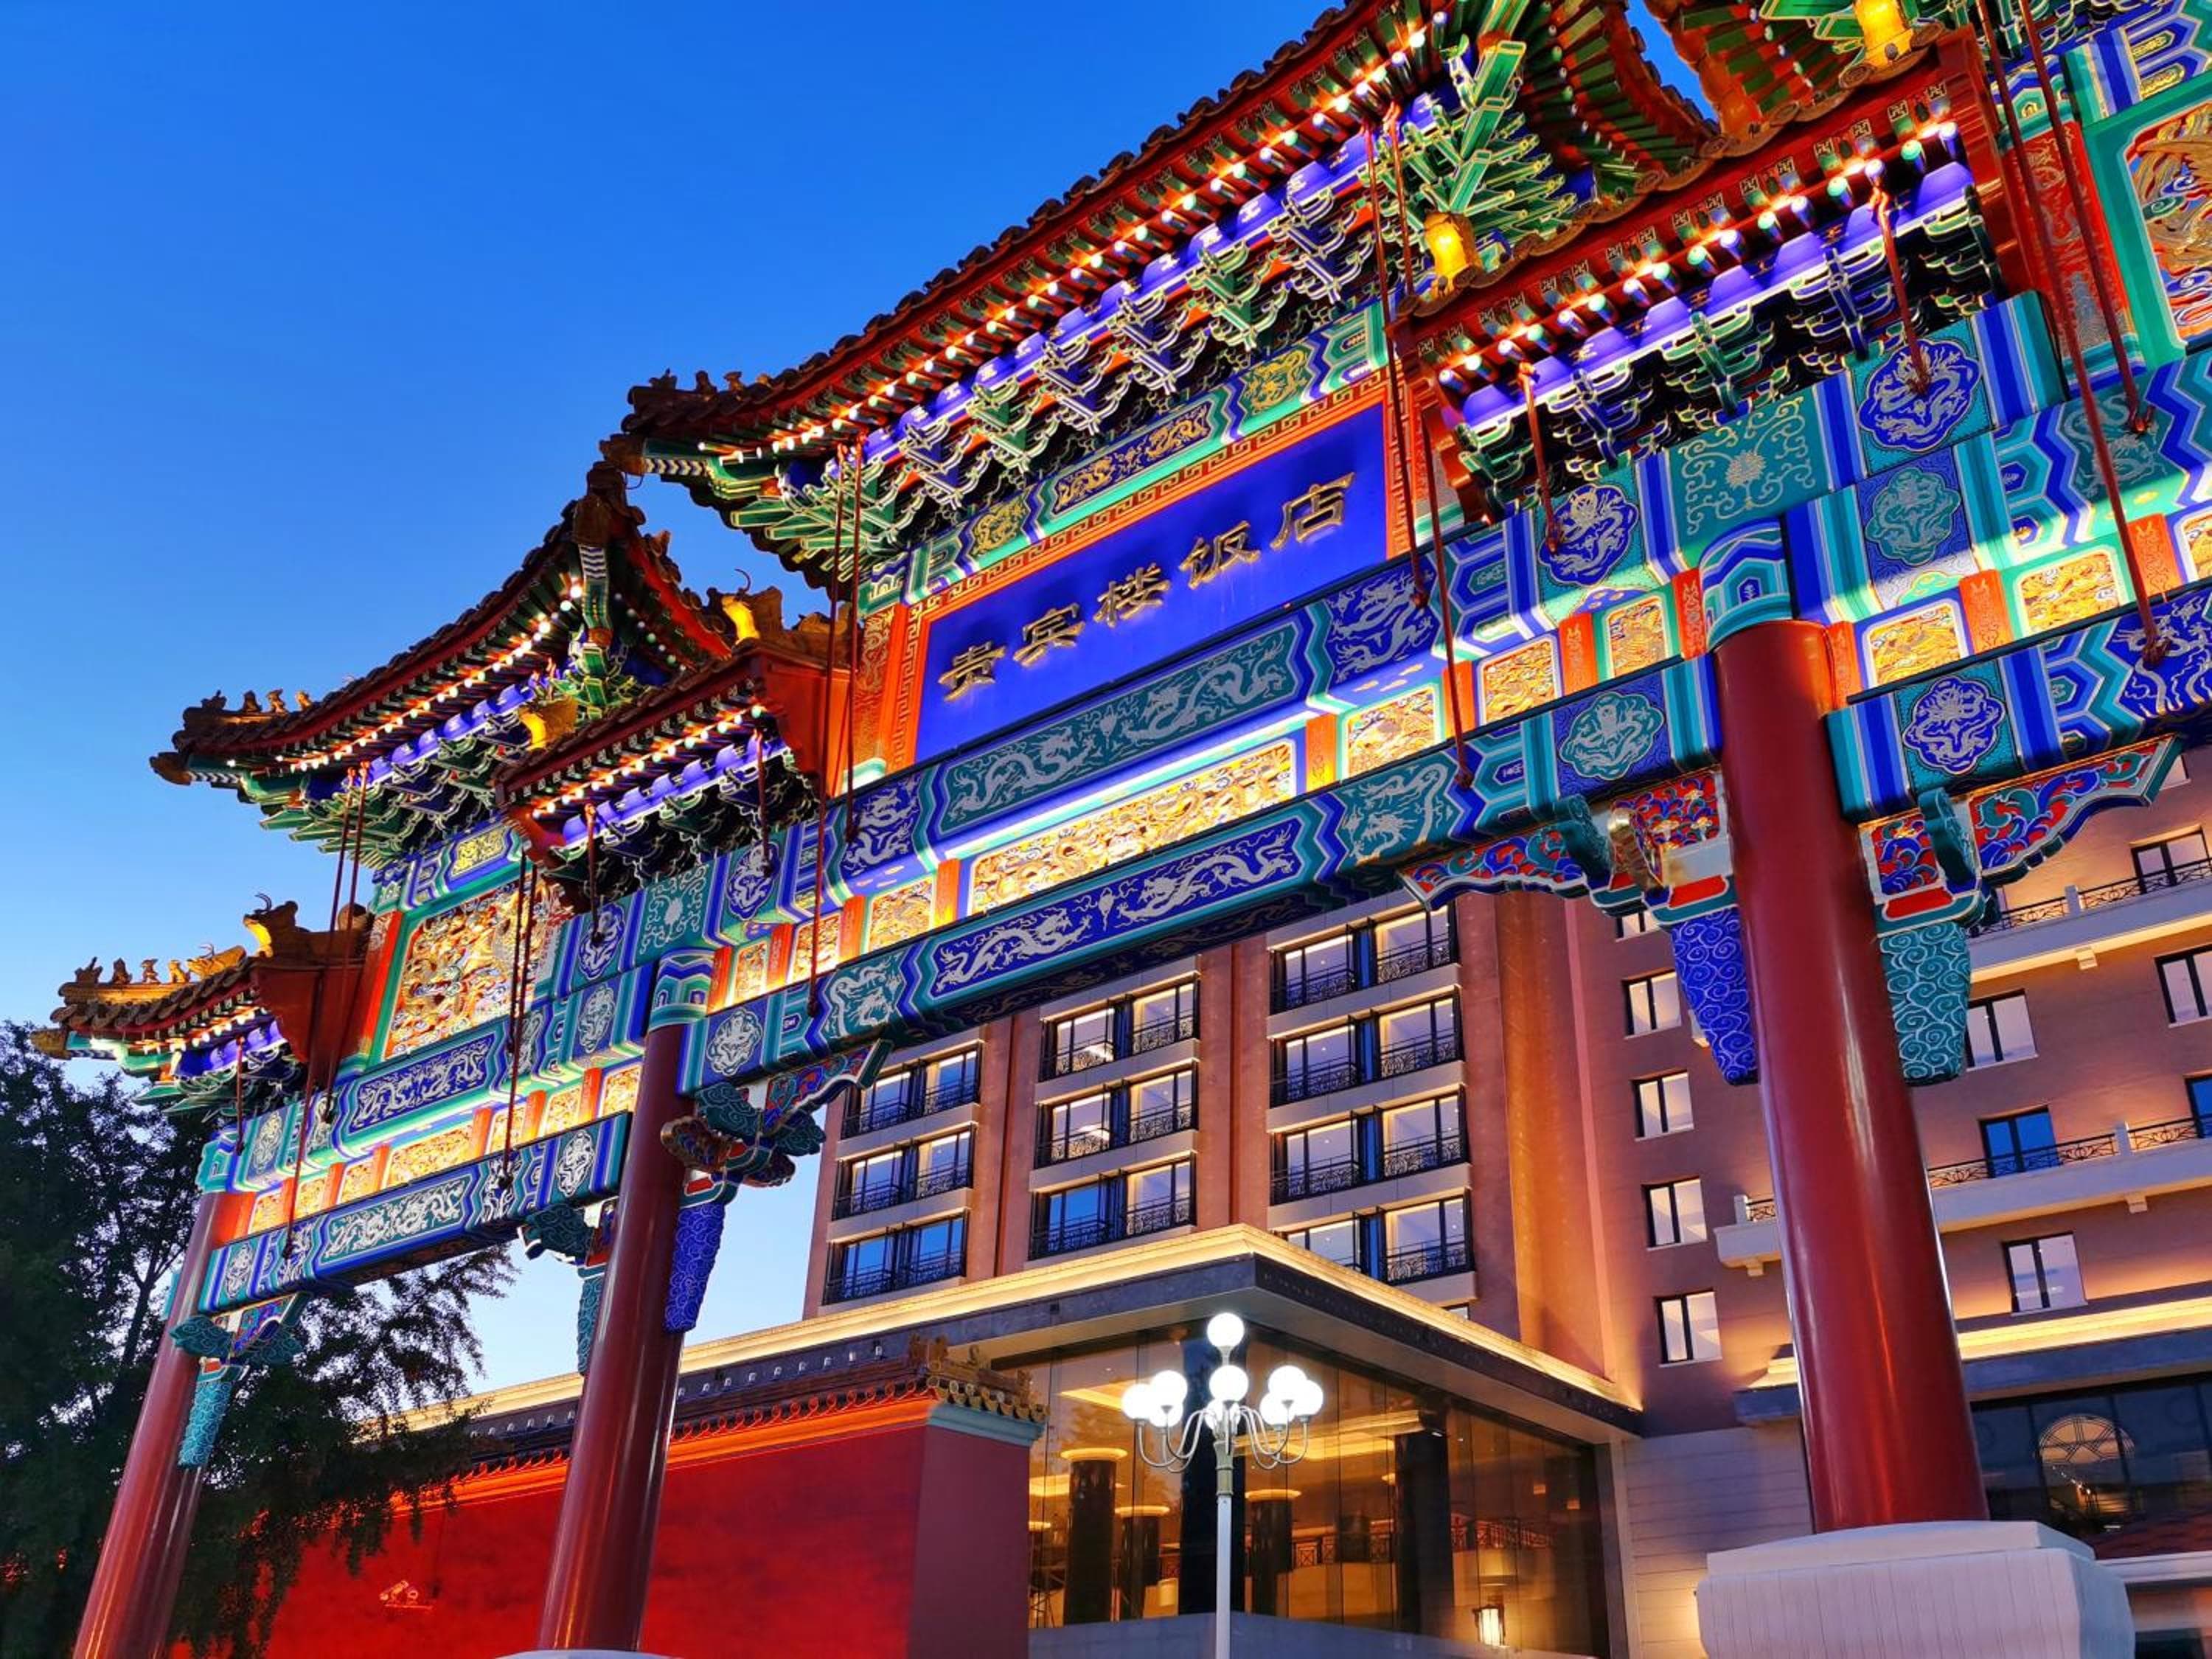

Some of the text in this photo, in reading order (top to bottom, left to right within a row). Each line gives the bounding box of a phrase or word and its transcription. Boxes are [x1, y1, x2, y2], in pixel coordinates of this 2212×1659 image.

[938, 472, 1355, 701] 贵宾楼饭店
